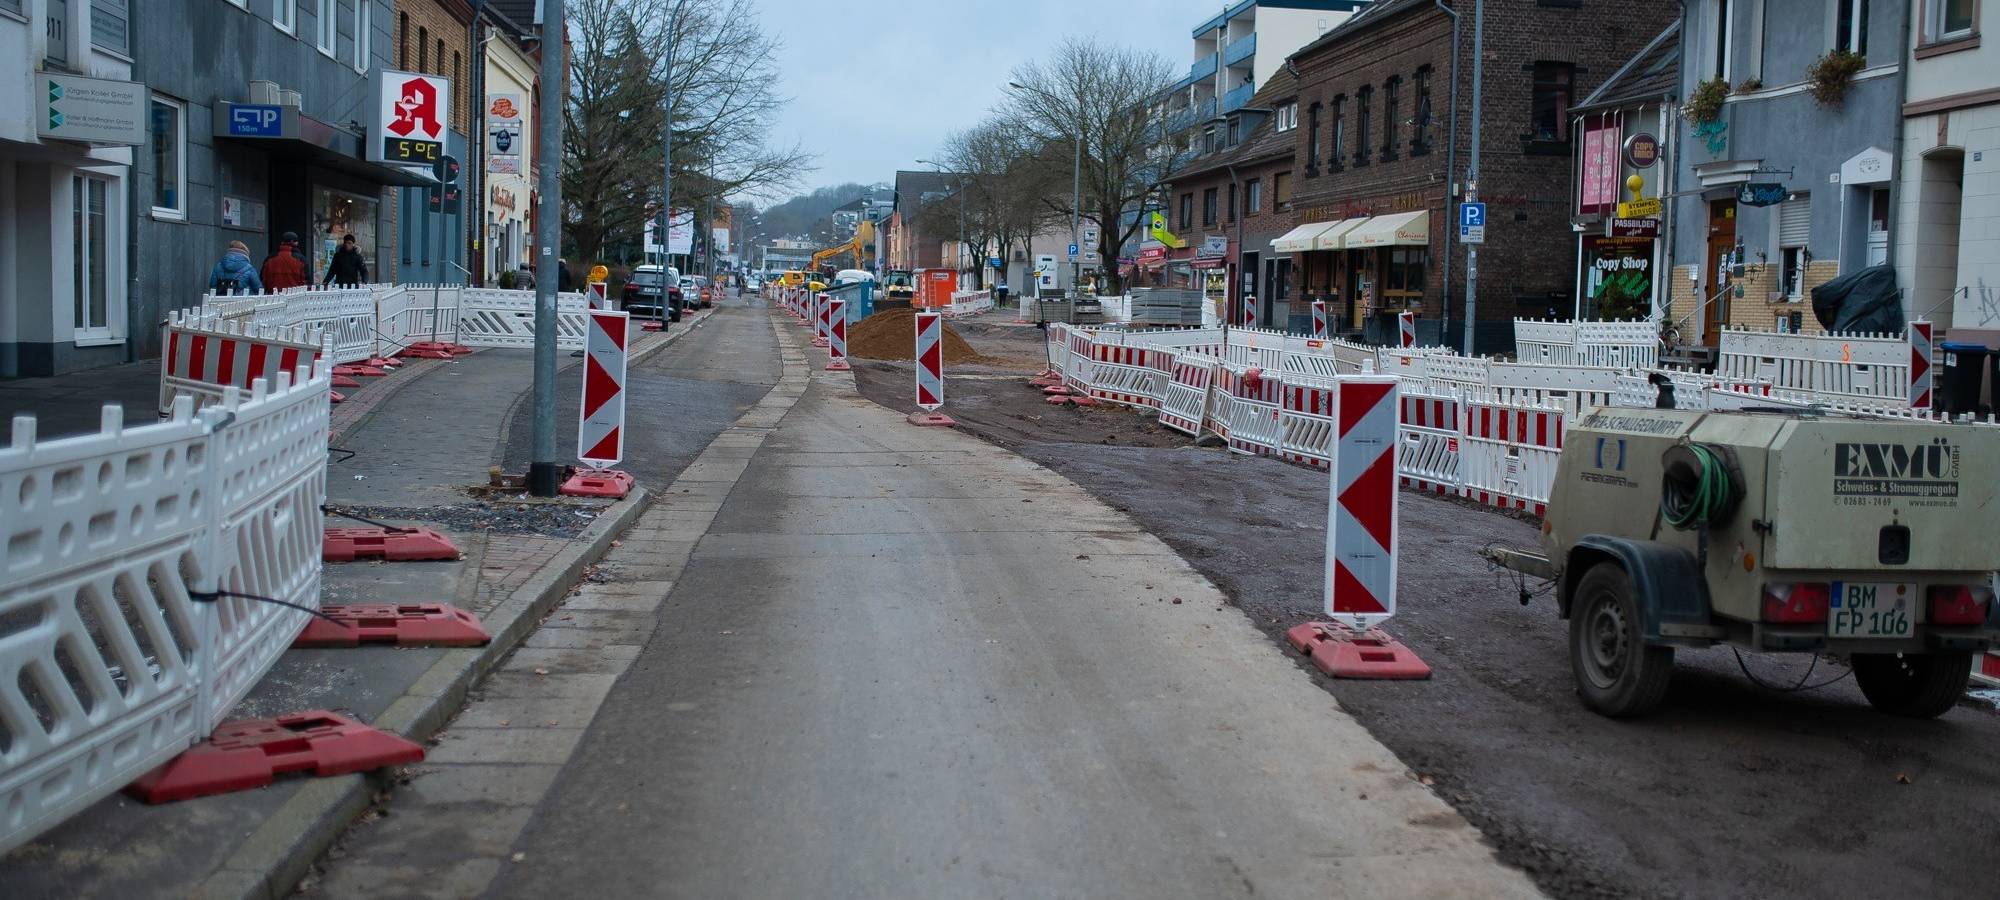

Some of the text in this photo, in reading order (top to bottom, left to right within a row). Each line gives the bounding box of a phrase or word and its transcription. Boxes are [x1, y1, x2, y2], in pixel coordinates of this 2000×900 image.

[263, 109, 277, 128] P
[400, 141, 410, 158] 5
[1628, 200, 1657, 210] STEMPEL
[1629, 207, 1658, 217] SERVICE
[1466, 206, 1480, 225] P
[1614, 219, 1655, 229] PASSBILDER
[1070, 245, 1077, 255] P
[1596, 257, 1648, 271] Copy Shop
[1834, 437, 1950, 479] EXMÜ
[1951, 445, 1960, 478] GMBH
[1836, 481, 1957, 497] Schweiss- & Stromaggregate
[1848, 585, 1877, 609] BM
[1835, 610, 1909, 635] FP 106
